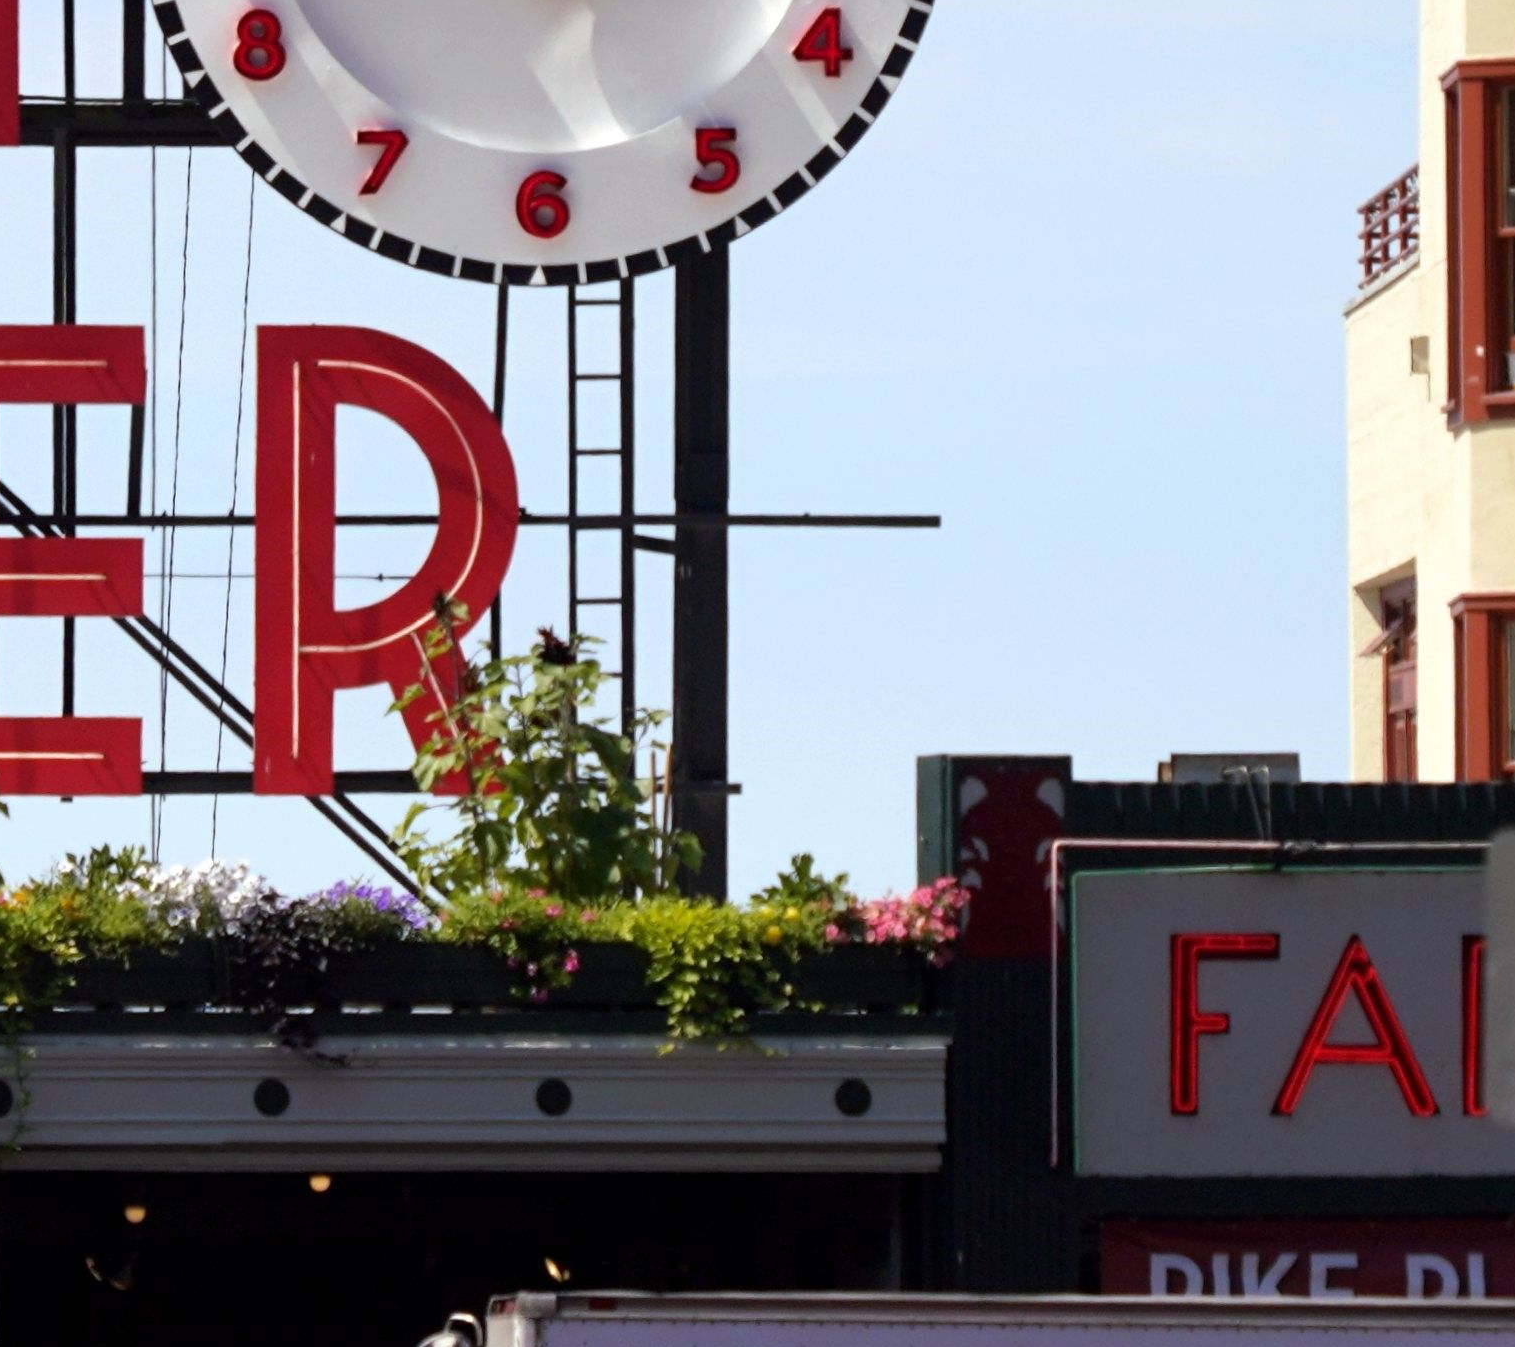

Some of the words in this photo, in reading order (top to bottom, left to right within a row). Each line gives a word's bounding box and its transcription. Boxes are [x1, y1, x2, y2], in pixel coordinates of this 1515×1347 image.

[233, 9, 286, 81] 8
[793, 7, 853, 77] 4
[357, 129, 408, 195] 7
[690, 127, 741, 193] 5
[516, 171, 569, 238] 6
